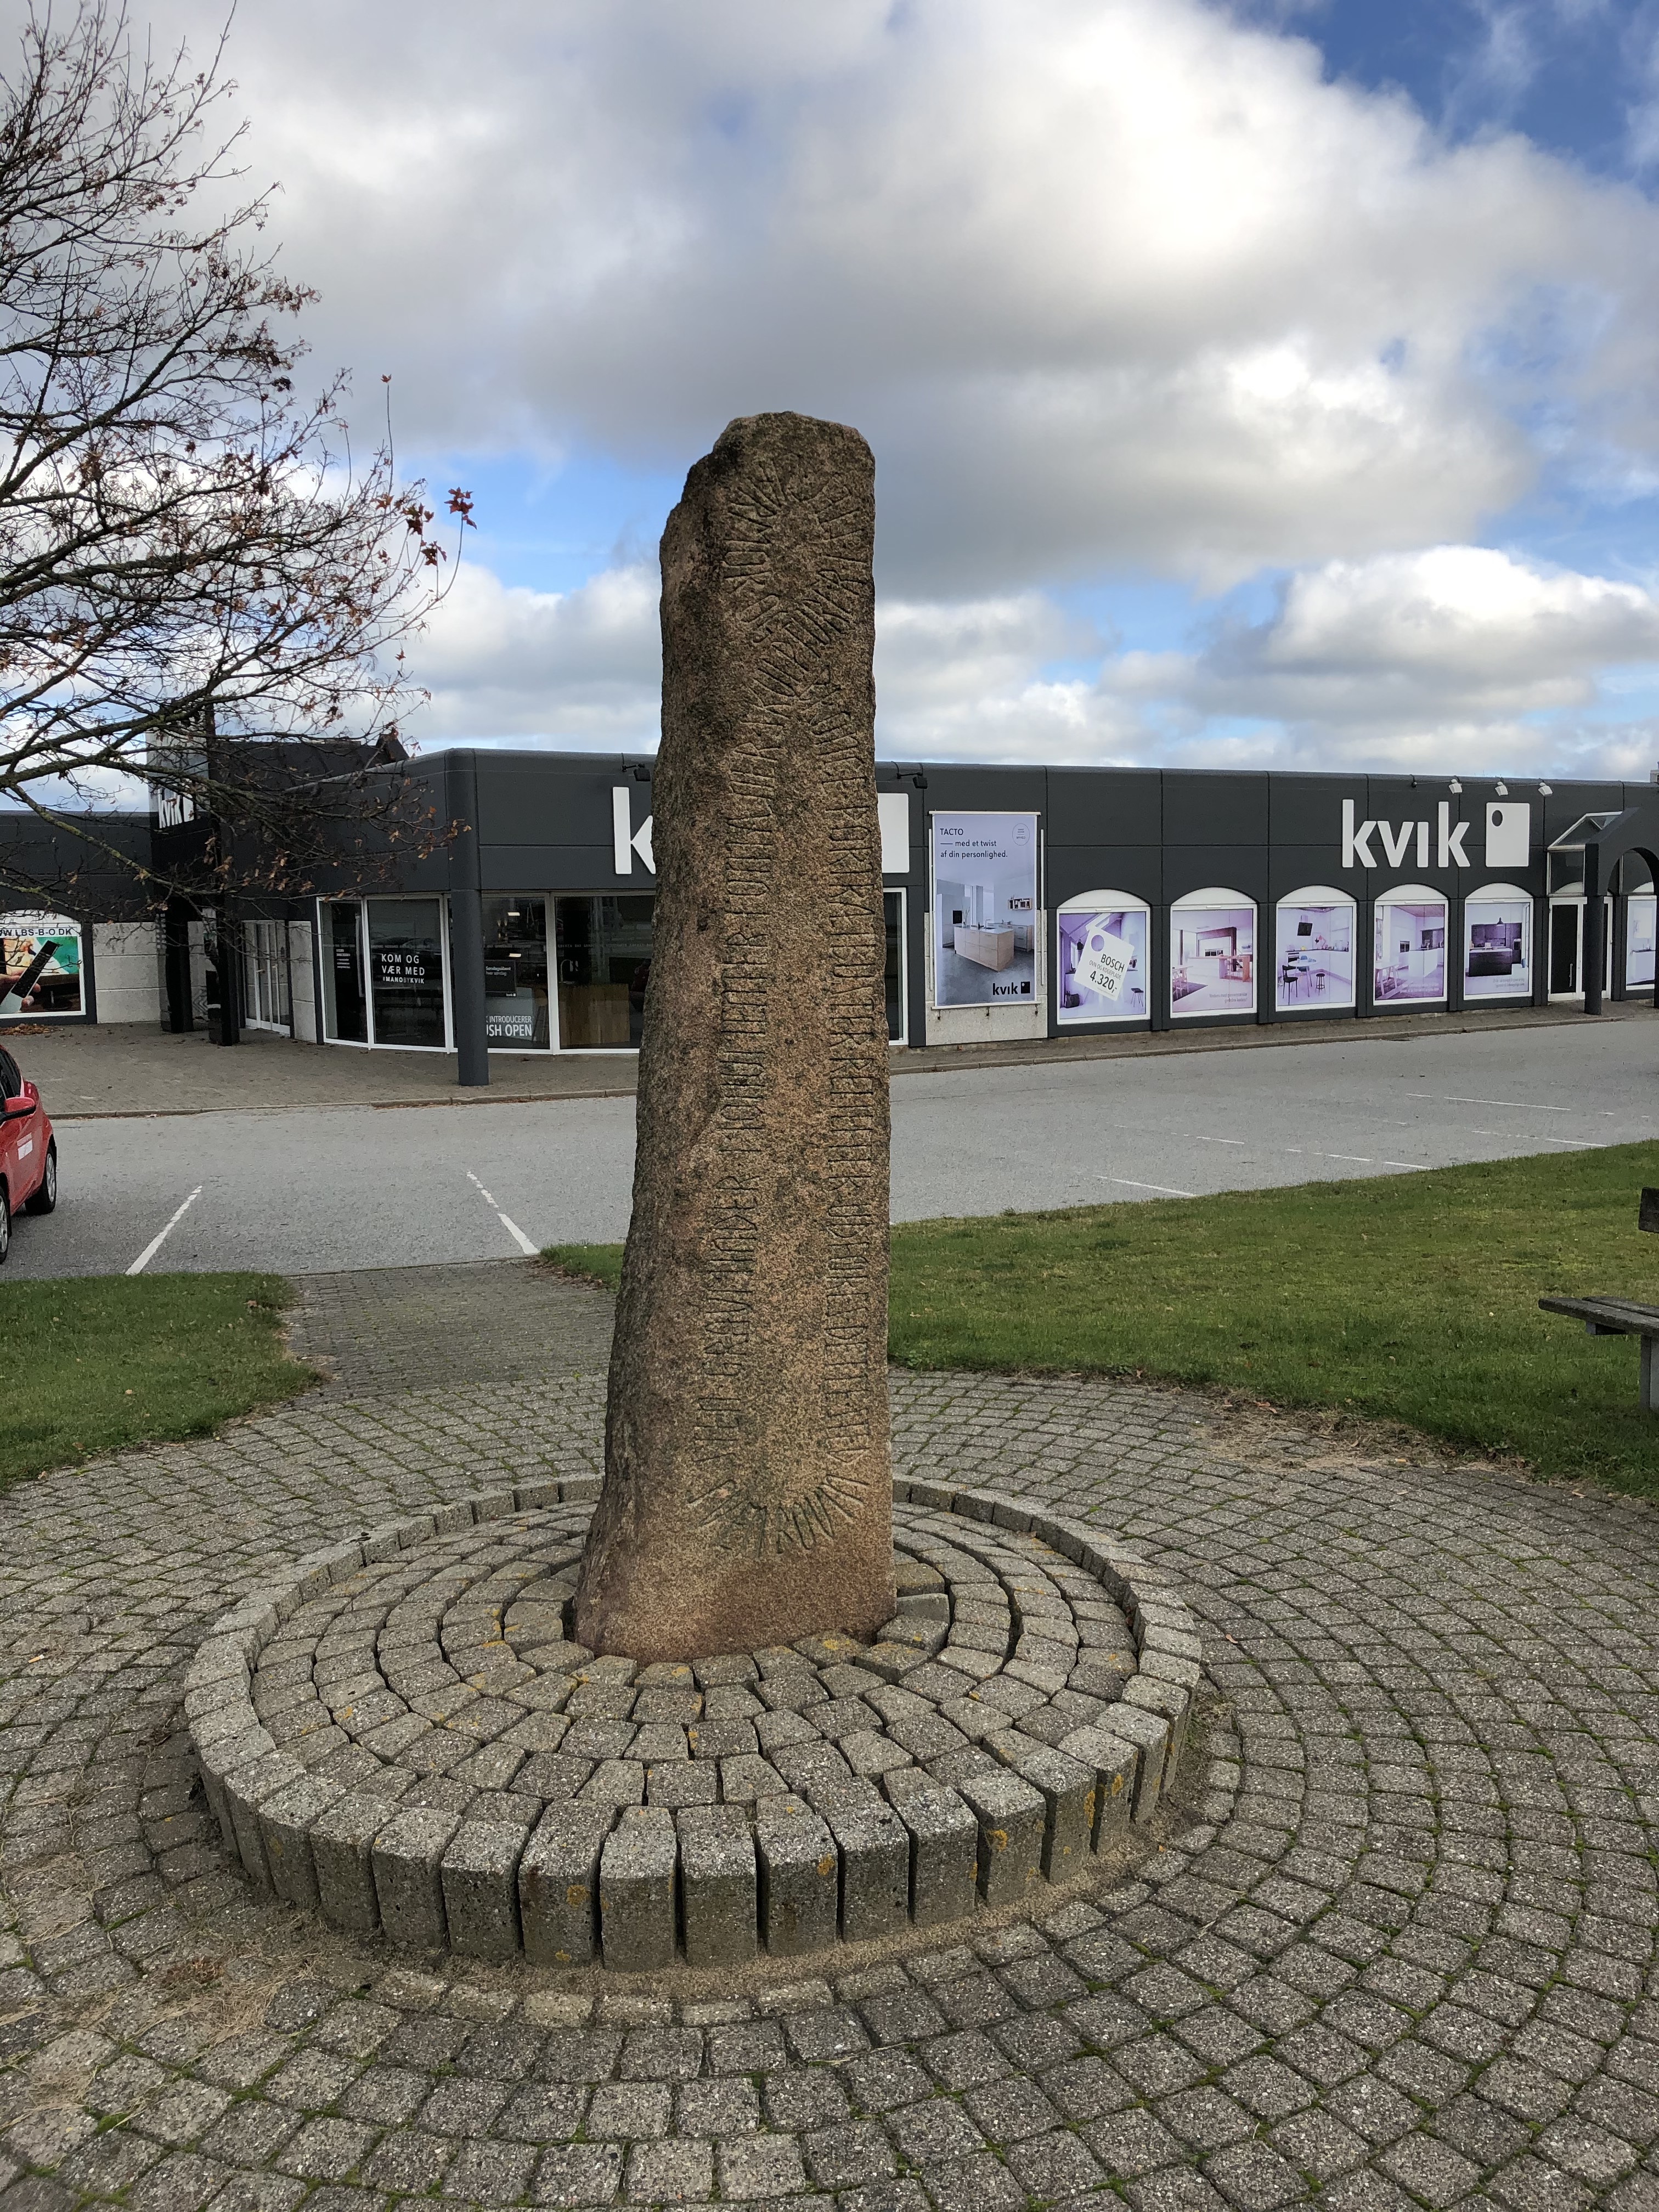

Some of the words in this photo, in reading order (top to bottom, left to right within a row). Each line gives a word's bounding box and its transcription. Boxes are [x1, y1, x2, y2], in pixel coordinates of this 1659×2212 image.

[1342, 799, 1470, 868] kvik
[962, 850, 1008, 860] personlighed.
[381, 953, 402, 963] KOM
[406, 955, 419, 963] OG
[1101, 953, 1125, 973] BOSCH
[381, 966, 401, 974] VÆR
[405, 967, 425, 975] MED
[992, 982, 1018, 996] kvik
[505, 1024, 532, 1036] OPEN
